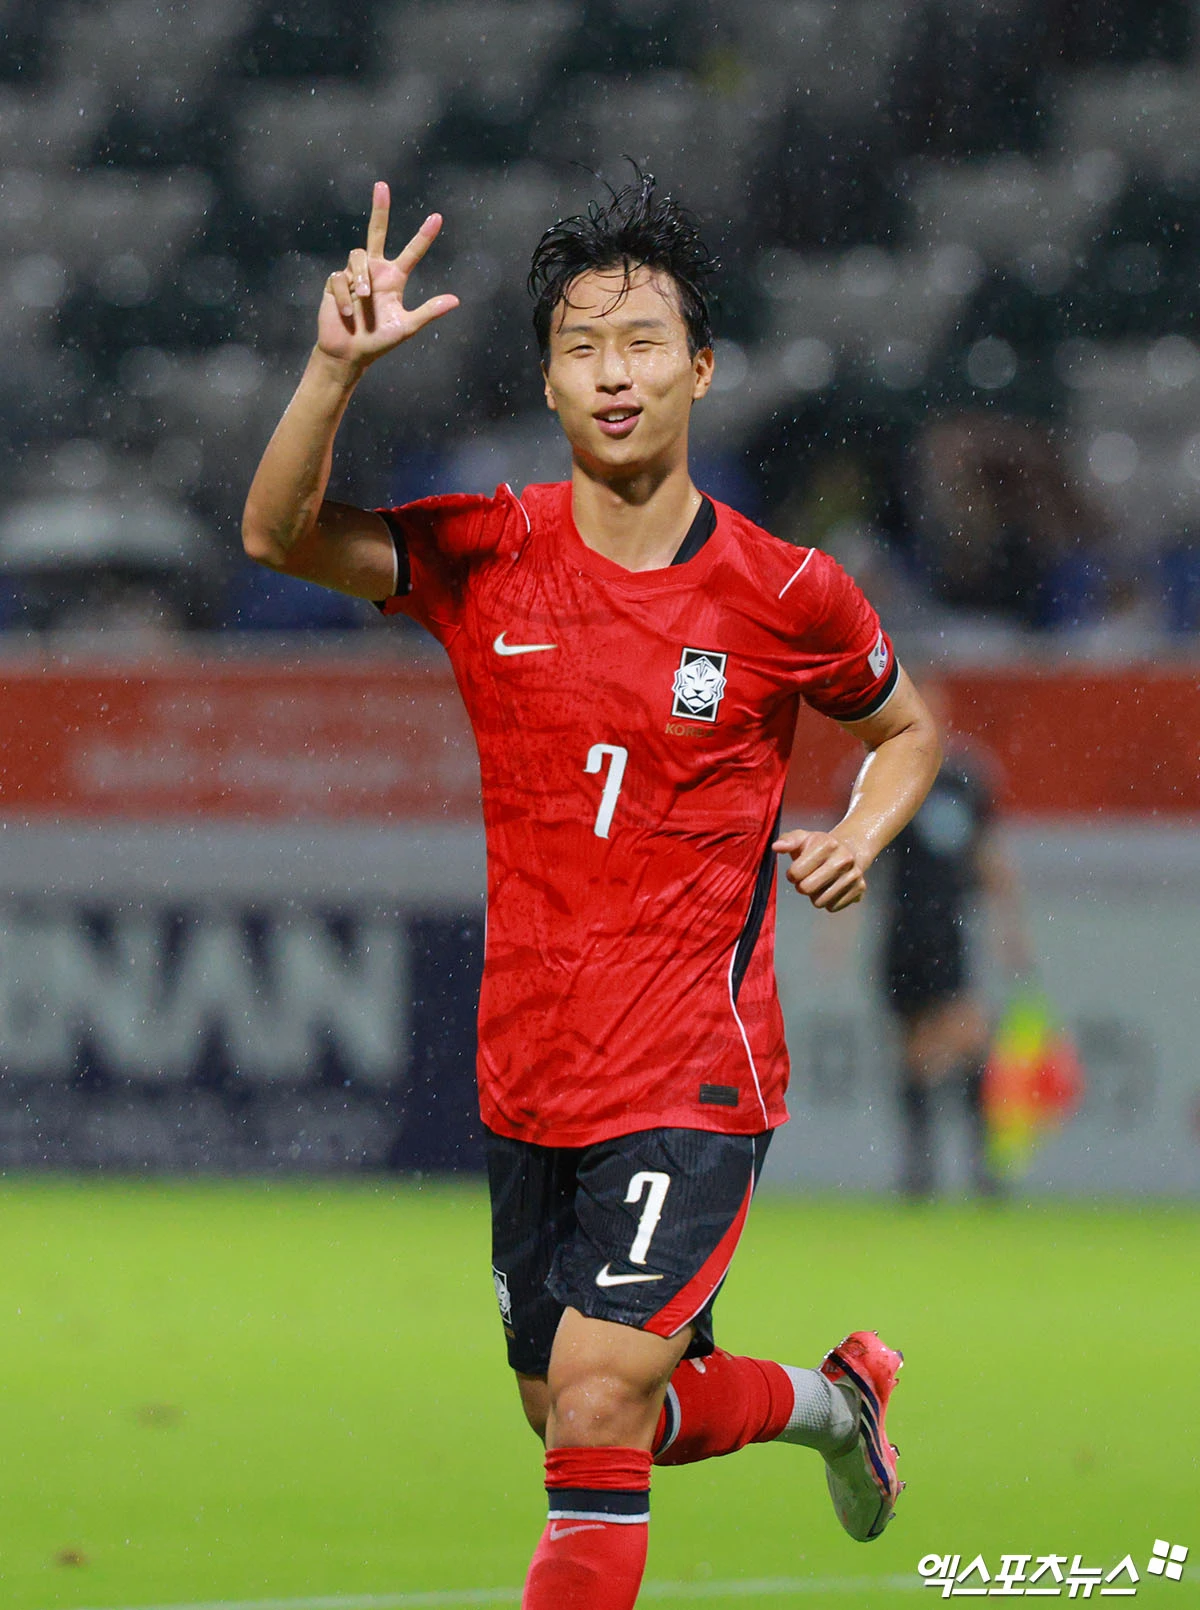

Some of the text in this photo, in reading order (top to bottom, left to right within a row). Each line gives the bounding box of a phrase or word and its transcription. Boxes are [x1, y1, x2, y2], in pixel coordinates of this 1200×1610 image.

[664, 722, 715, 738] KOREA
[584, 744, 627, 838] 7
[624, 1172, 670, 1264] 7
